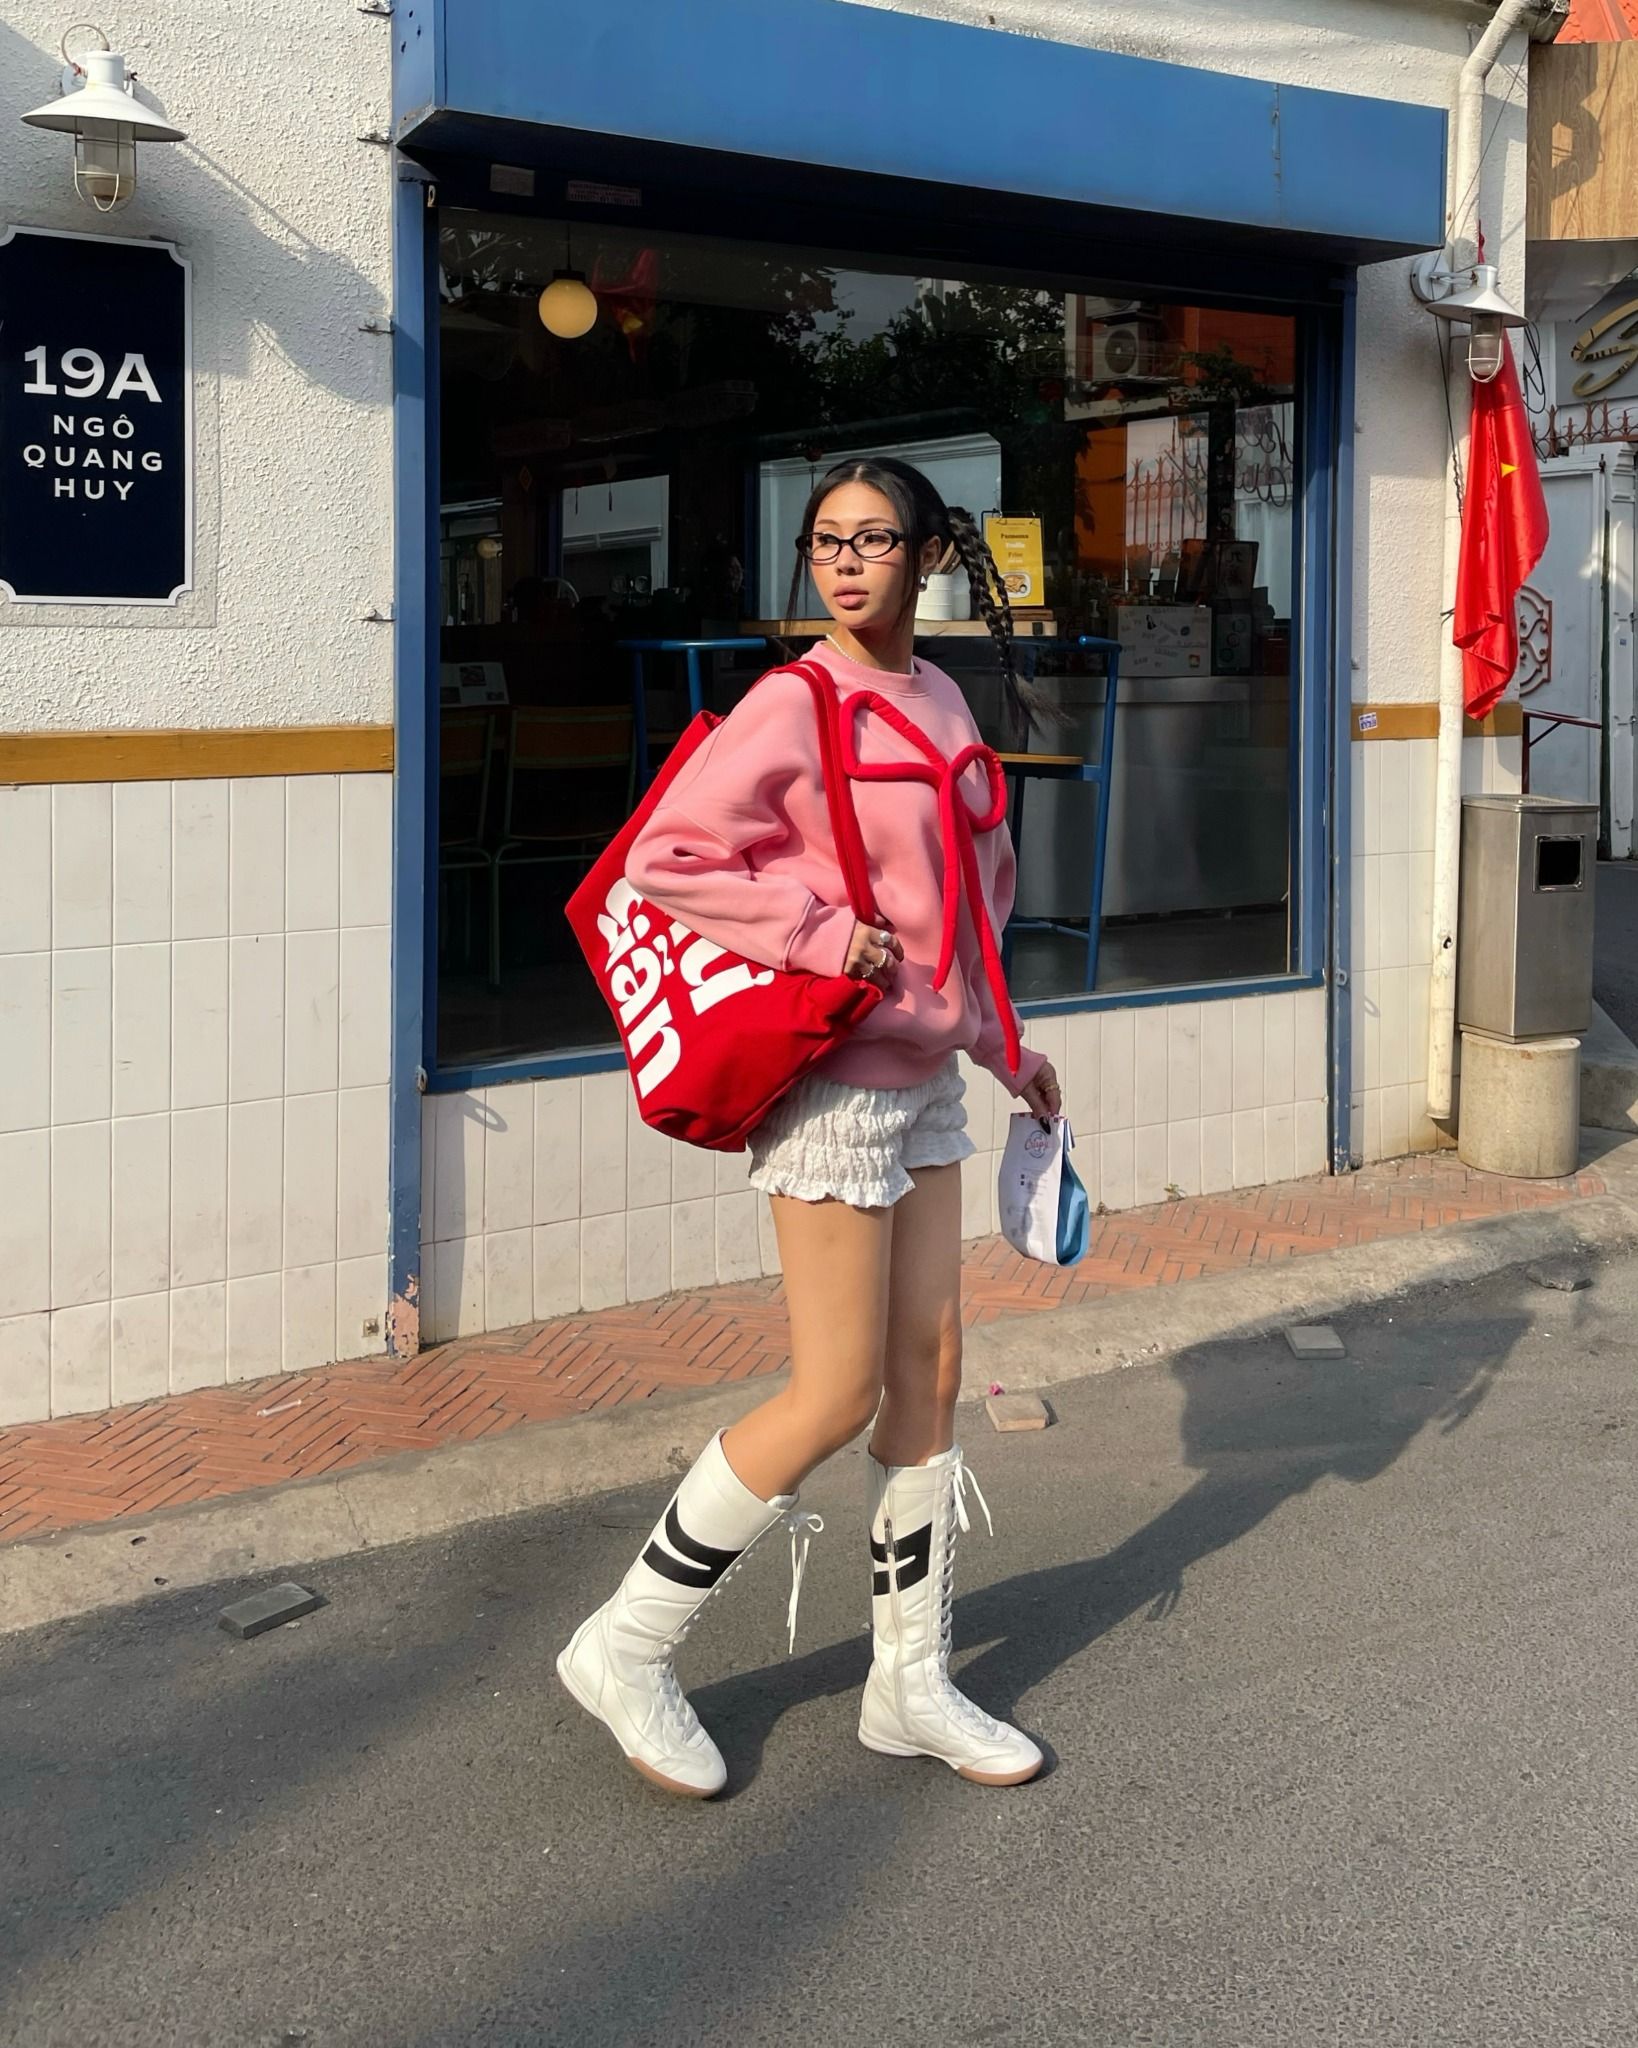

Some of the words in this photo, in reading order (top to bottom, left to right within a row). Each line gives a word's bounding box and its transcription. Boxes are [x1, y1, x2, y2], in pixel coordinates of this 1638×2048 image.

[24, 345, 163, 403] 19A
[53, 413, 135, 439] NGÔ
[23, 444, 163, 472] QUANG
[54, 477, 135, 501] HUY
